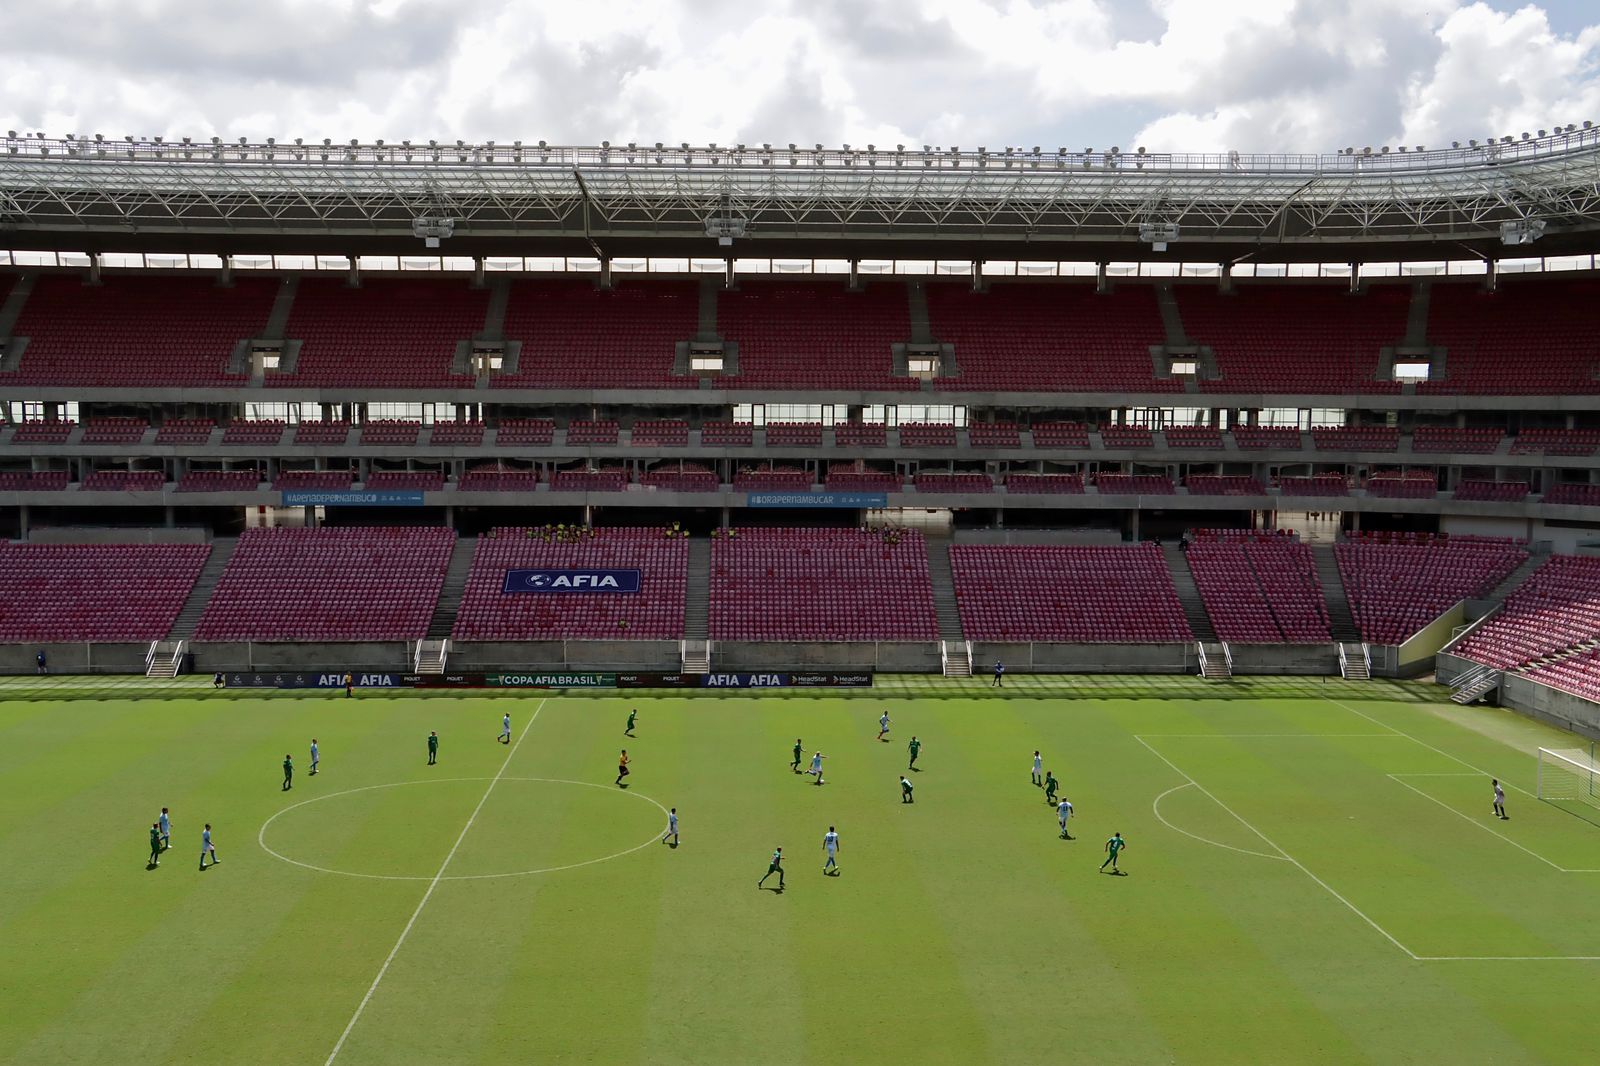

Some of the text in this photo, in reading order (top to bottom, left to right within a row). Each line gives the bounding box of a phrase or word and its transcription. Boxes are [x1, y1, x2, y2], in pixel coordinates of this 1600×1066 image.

[551, 575, 619, 587] AFIA
[360, 674, 392, 686] AFIA
[504, 675, 597, 685] COPA AFIA BRASIL
[707, 674, 740, 686] AFIA
[748, 674, 781, 686] AFIA
